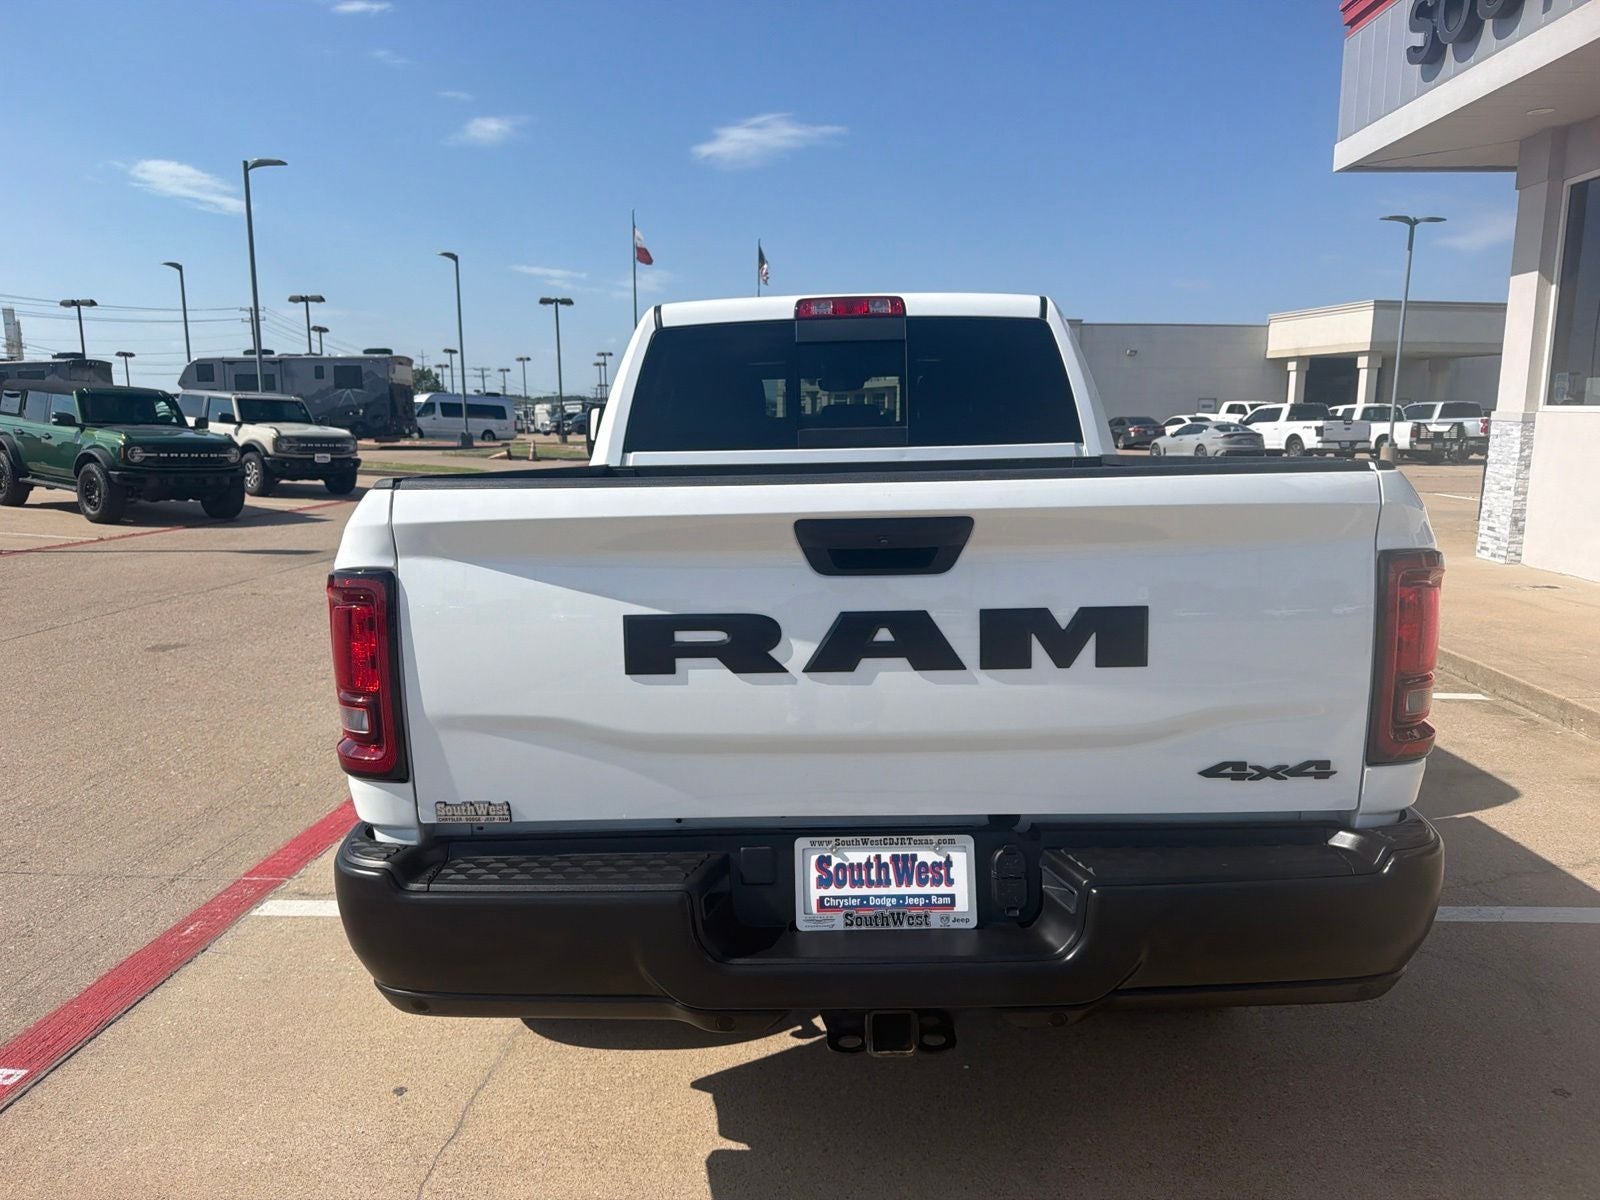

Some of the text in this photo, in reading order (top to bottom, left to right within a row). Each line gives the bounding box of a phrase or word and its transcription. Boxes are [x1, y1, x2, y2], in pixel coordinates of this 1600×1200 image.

[622, 605, 1149, 675] RAM
[1197, 759, 1338, 781] 4x4
[436, 802, 510, 816] SouthWest
[815, 853, 955, 889] SouthWest
[824, 895, 951, 908] Chrysler Dodge Jeep Ram
[844, 911, 931, 928] SouthWest
